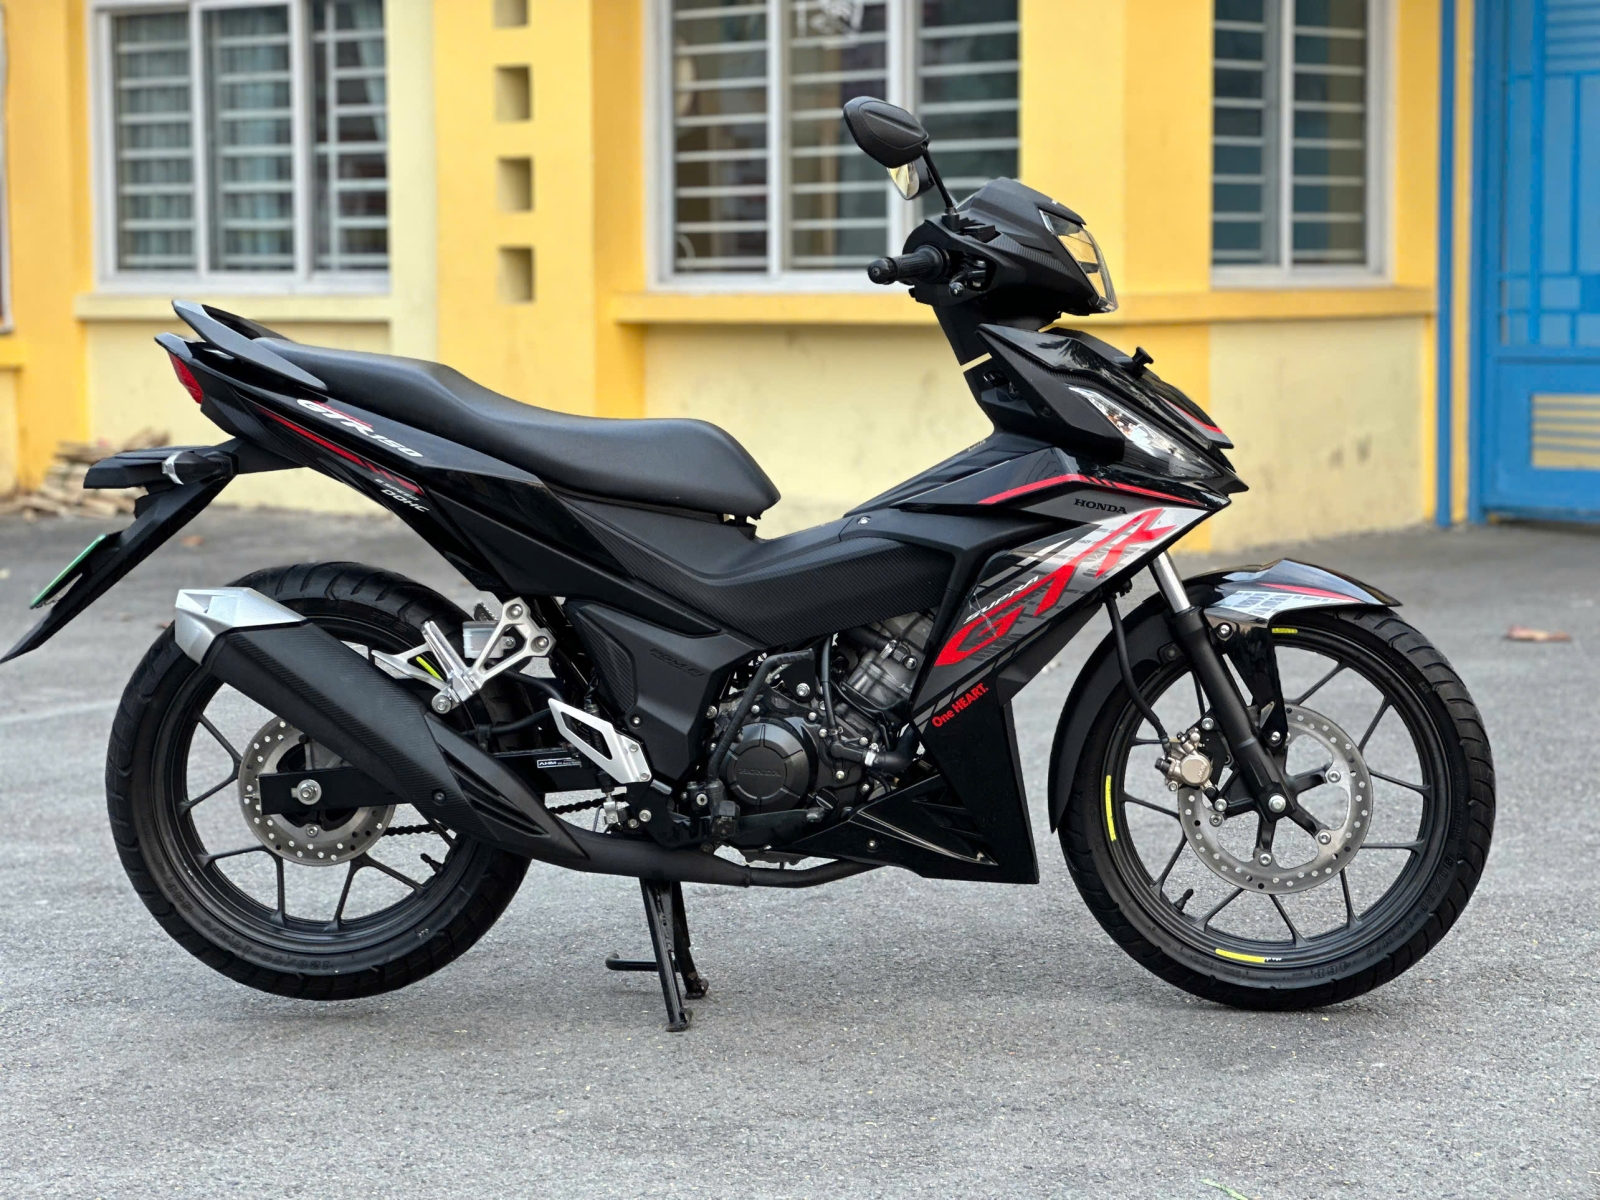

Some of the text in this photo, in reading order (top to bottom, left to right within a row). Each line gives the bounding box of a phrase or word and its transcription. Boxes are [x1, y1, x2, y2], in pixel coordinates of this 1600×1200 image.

[380, 489, 430, 513] DOHC
[1074, 498, 1128, 515] HONDA
[963, 575, 1039, 625] SUPRA
[931, 709, 955, 728] One
[738, 768, 782, 778] HONDA
